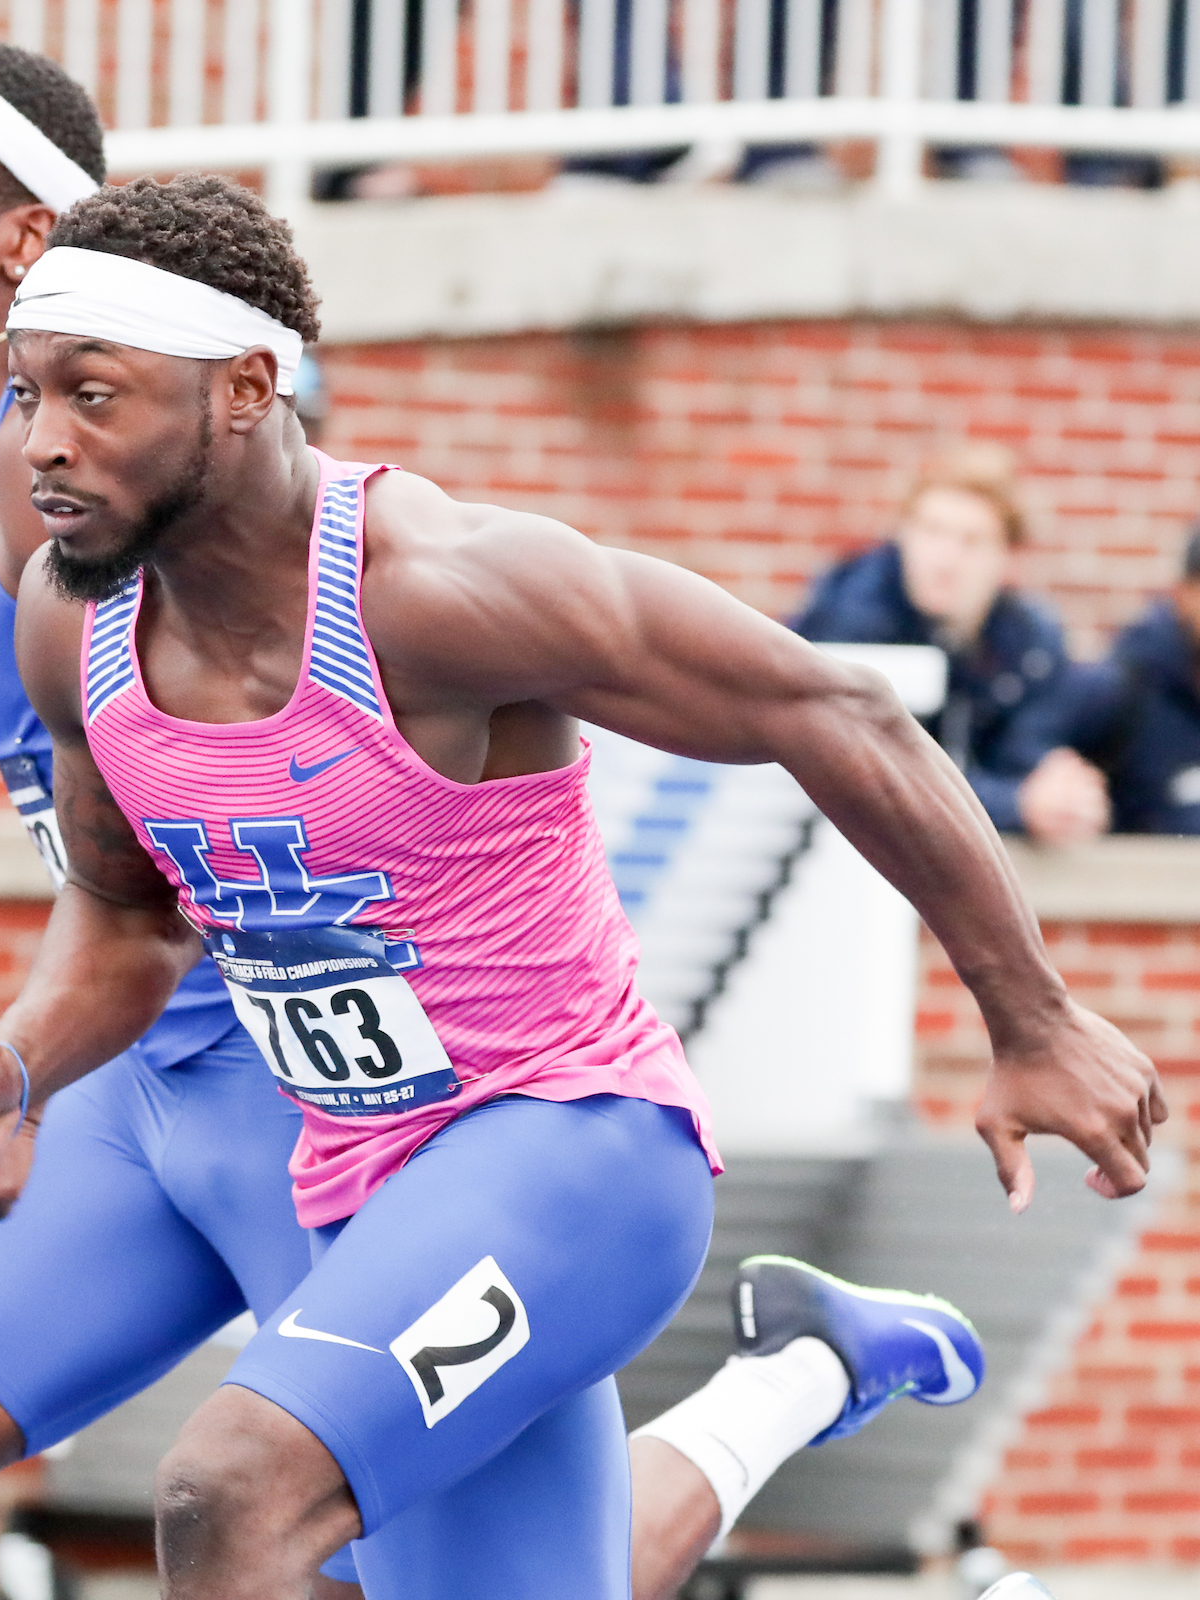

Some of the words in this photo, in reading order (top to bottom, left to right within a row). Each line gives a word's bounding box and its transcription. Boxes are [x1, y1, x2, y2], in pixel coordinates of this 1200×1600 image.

[287, 957, 379, 980] CHAMPIONSHIPS
[246, 988, 403, 1082] 763
[338, 1093, 351, 1105] KY
[361, 1093, 383, 1105] MAY
[382, 1085, 415, 1104] 25-27
[409, 1284, 517, 1408] 2
